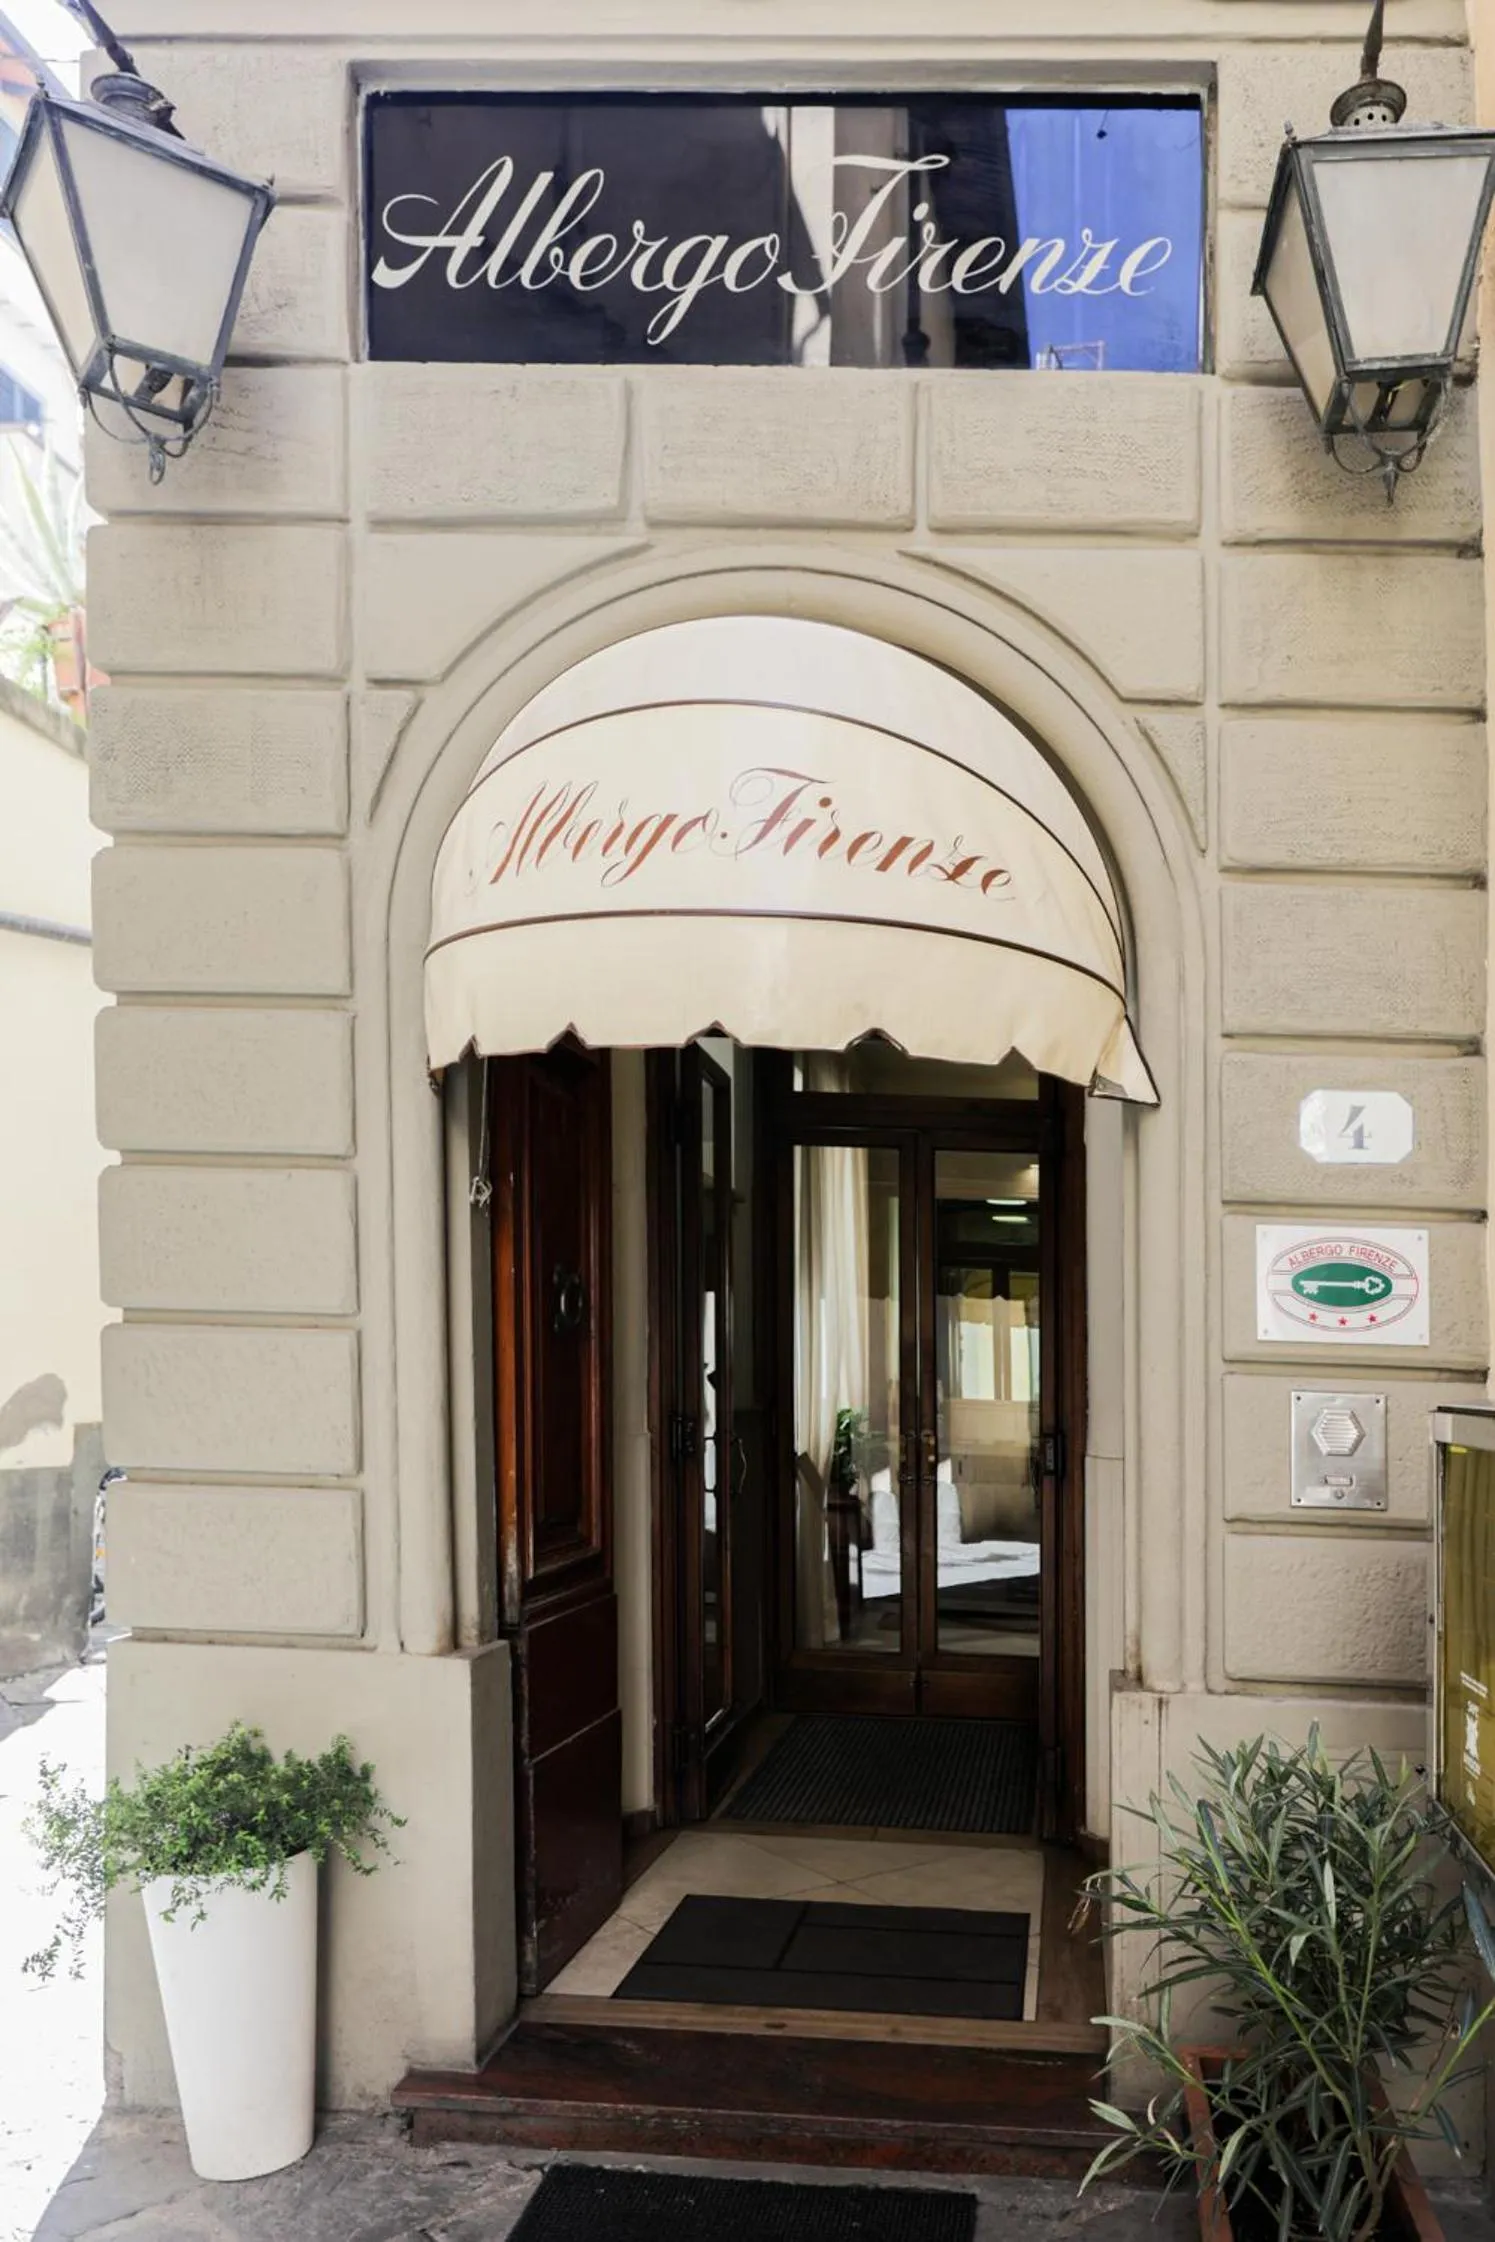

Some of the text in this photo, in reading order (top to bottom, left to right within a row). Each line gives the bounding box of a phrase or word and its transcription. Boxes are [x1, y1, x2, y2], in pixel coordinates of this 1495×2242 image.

[370, 153, 1174, 347] Albergo Firenze
[464, 766, 1016, 900] Albergo Firenze
[1338, 1104, 1372, 1150] 4
[1288, 1243, 1398, 1271] ALBERGO FIRENZE
